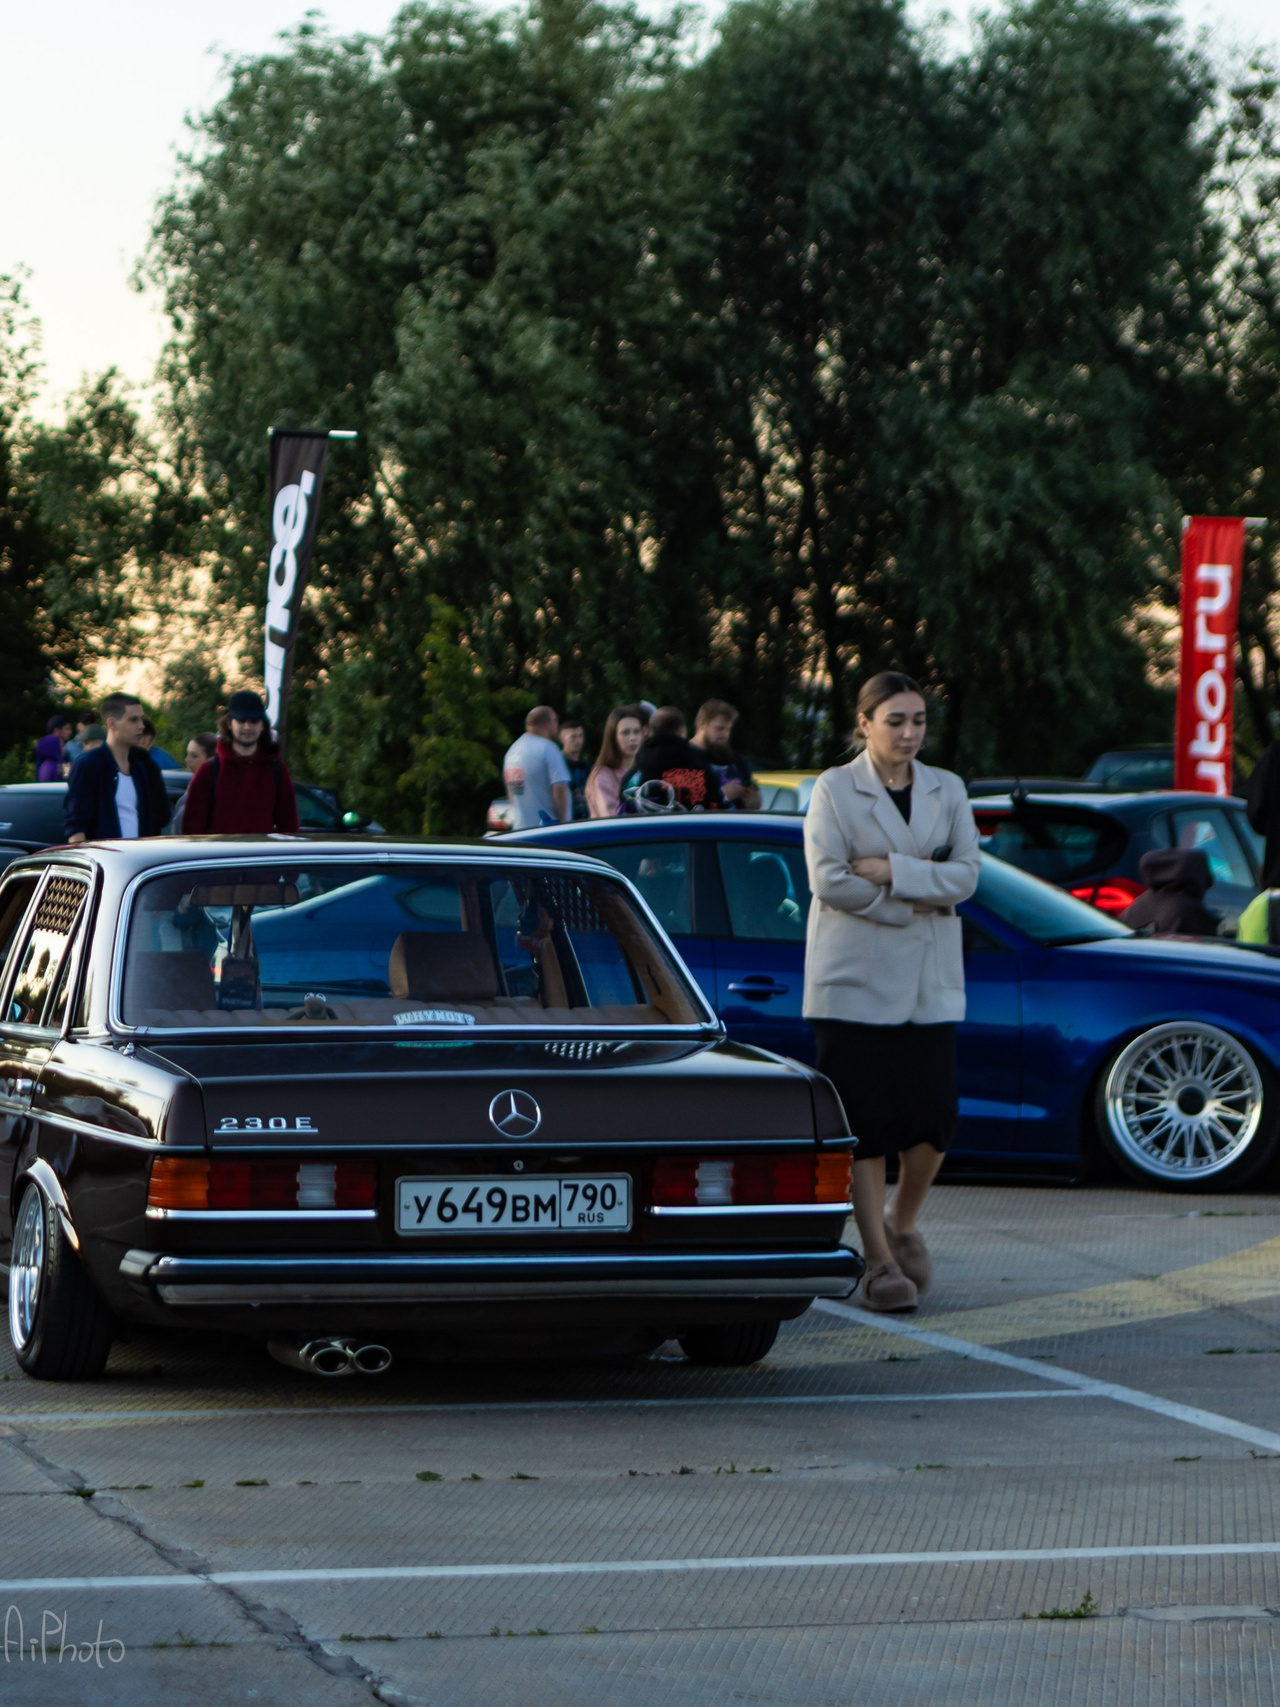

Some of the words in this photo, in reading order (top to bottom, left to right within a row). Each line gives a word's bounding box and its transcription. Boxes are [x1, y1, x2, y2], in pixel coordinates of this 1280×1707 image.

[1188, 563, 1233, 797] uto.ru
[413, 1186, 557, 1223] У649ВМ
[563, 1182, 617, 1212] 790
[577, 1212, 605, 1223] RUS
